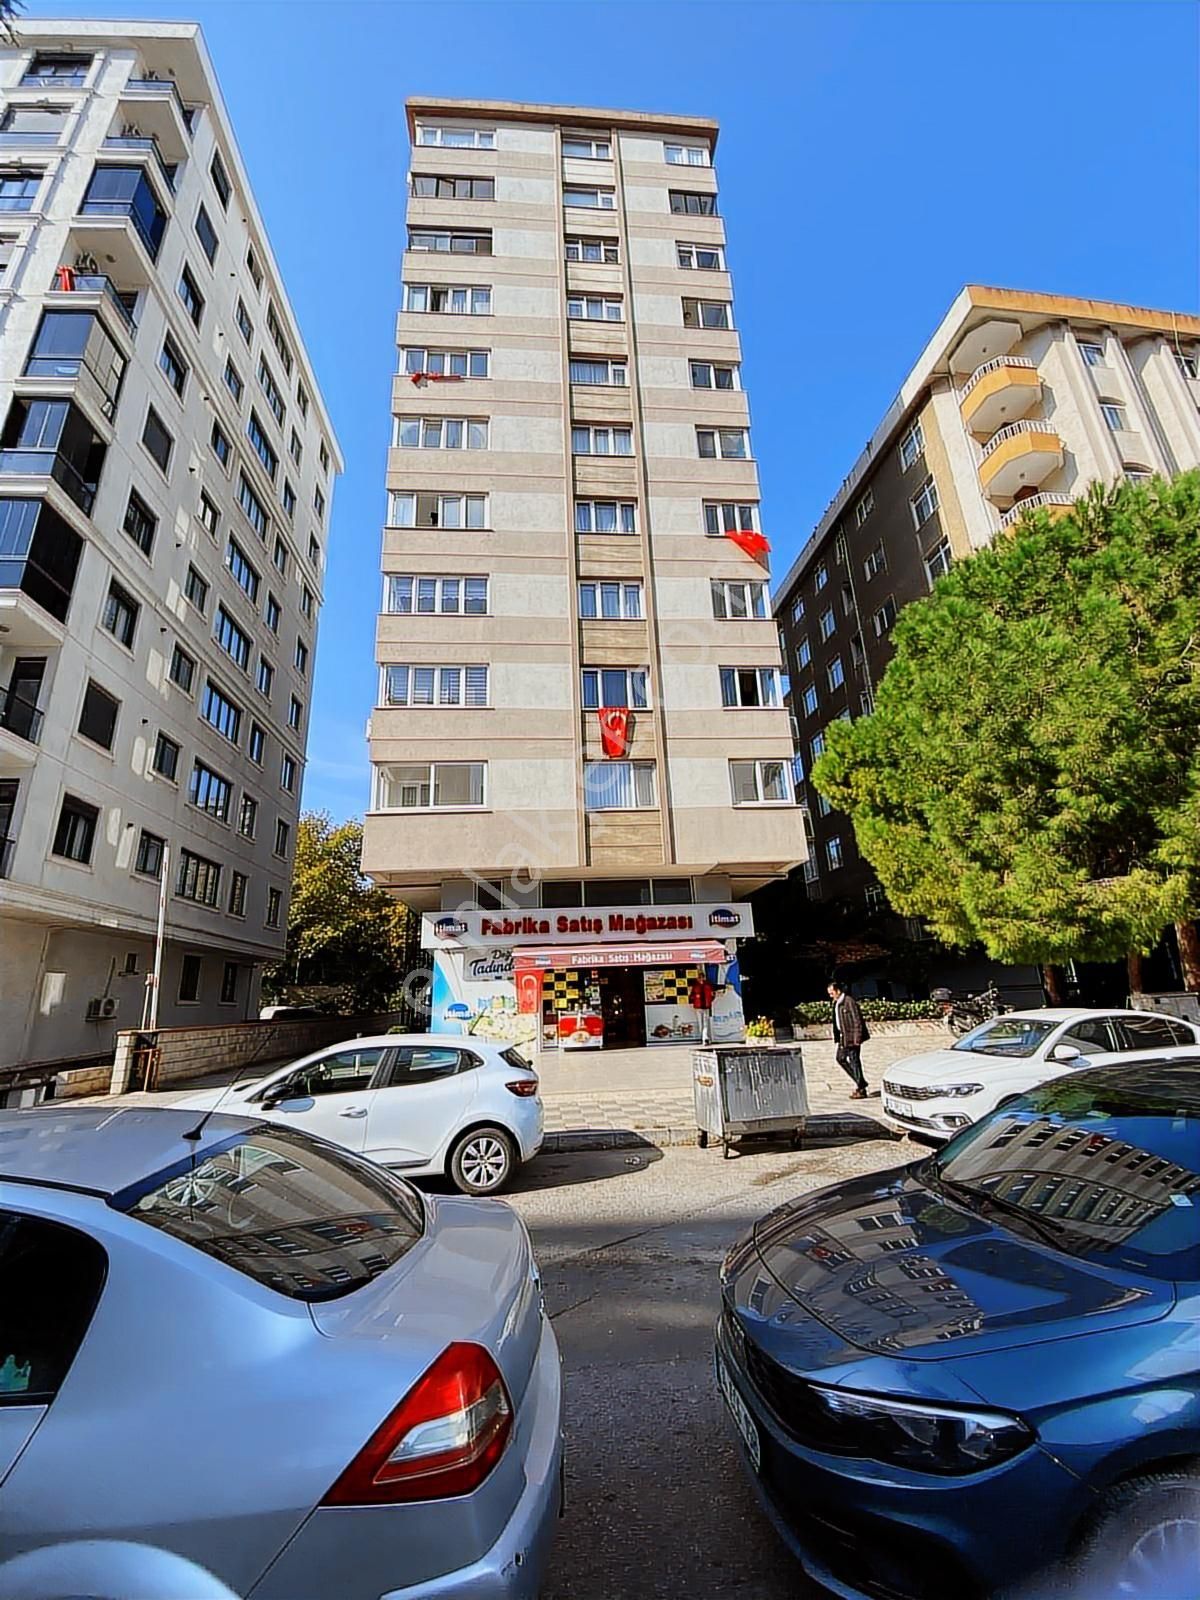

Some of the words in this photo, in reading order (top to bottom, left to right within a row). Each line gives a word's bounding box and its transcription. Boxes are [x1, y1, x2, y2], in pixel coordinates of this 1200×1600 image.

[481, 916, 550, 936] Fabrika
[557, 915, 603, 935] Satış
[608, 914, 693, 934] Mağazası
[571, 954, 604, 965] Fabrika
[608, 953, 629, 964] Satış
[633, 951, 673, 962] Mağazası
